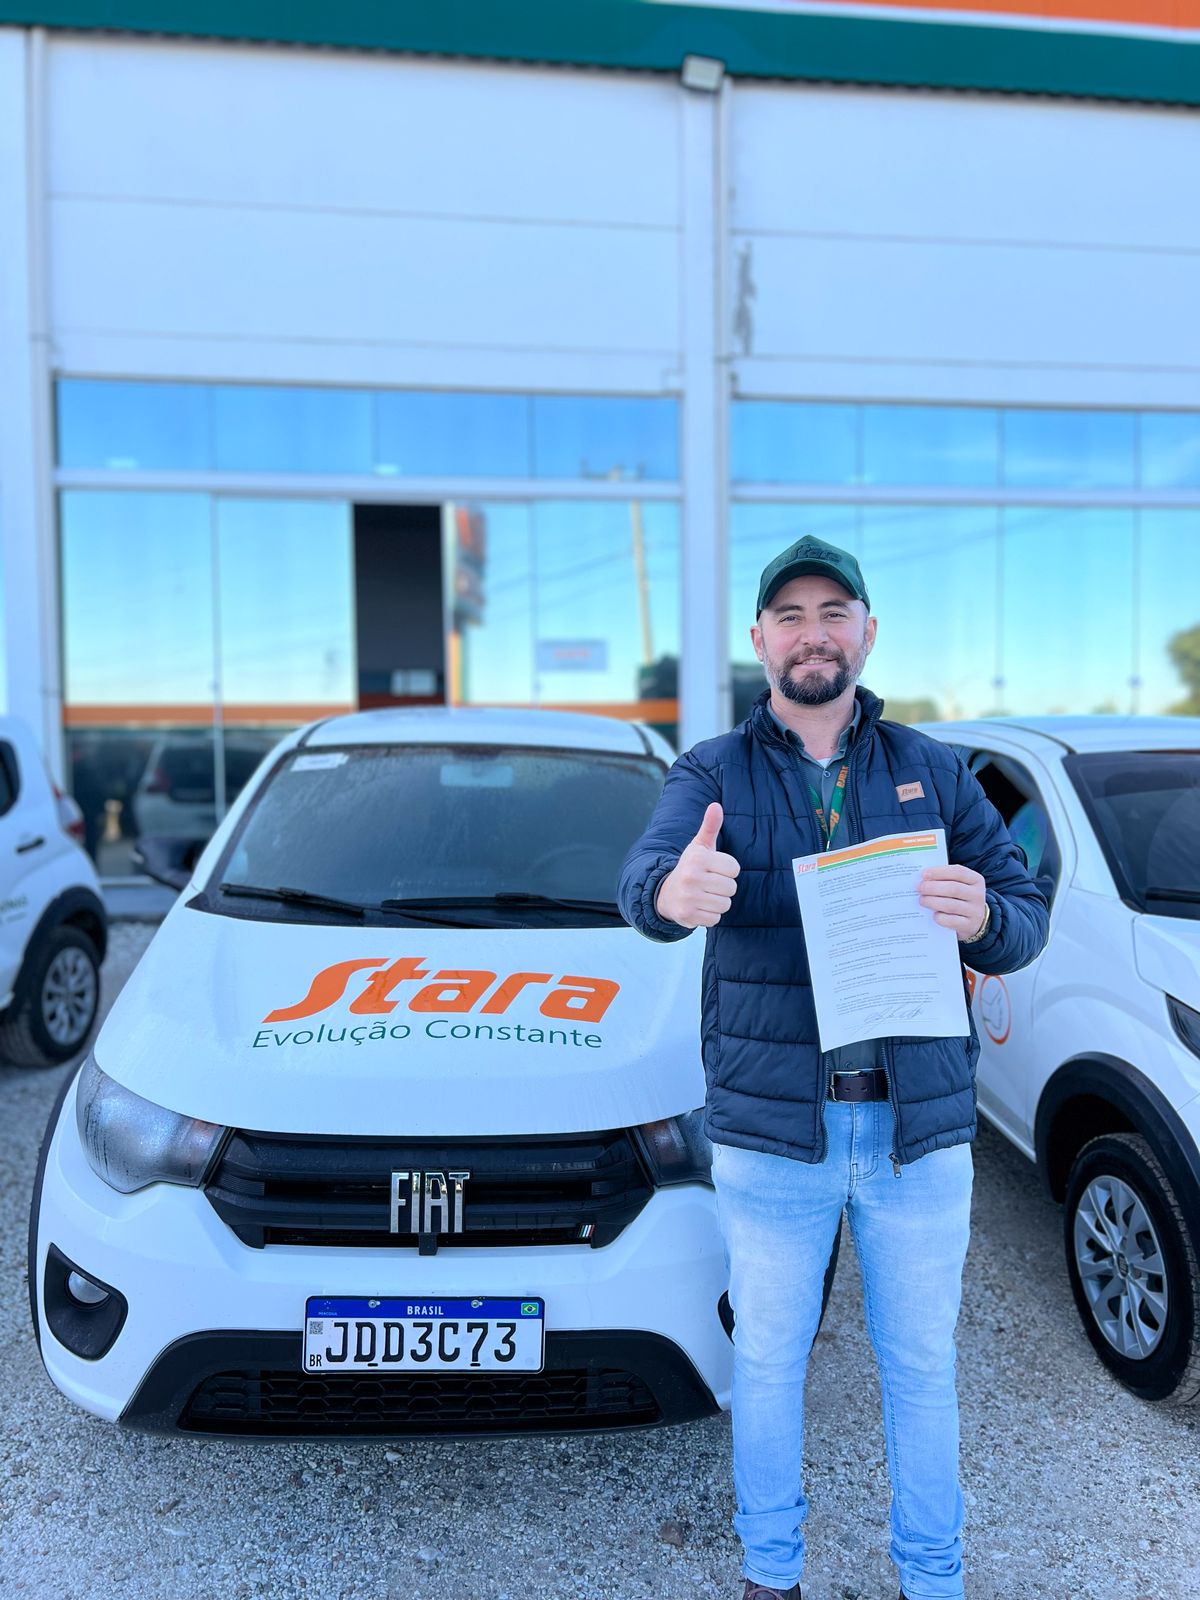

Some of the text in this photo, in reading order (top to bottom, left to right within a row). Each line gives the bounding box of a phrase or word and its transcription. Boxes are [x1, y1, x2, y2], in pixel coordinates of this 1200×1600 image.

[797, 862, 817, 875] Stara
[261, 957, 621, 1024] Stara
[252, 1019, 603, 1048] Evolução Constante
[390, 1171, 470, 1233] FIAT
[407, 1305, 444, 1316] BRASIL
[325, 1322, 517, 1366] JDD3C73
[309, 1354, 322, 1367] BR
